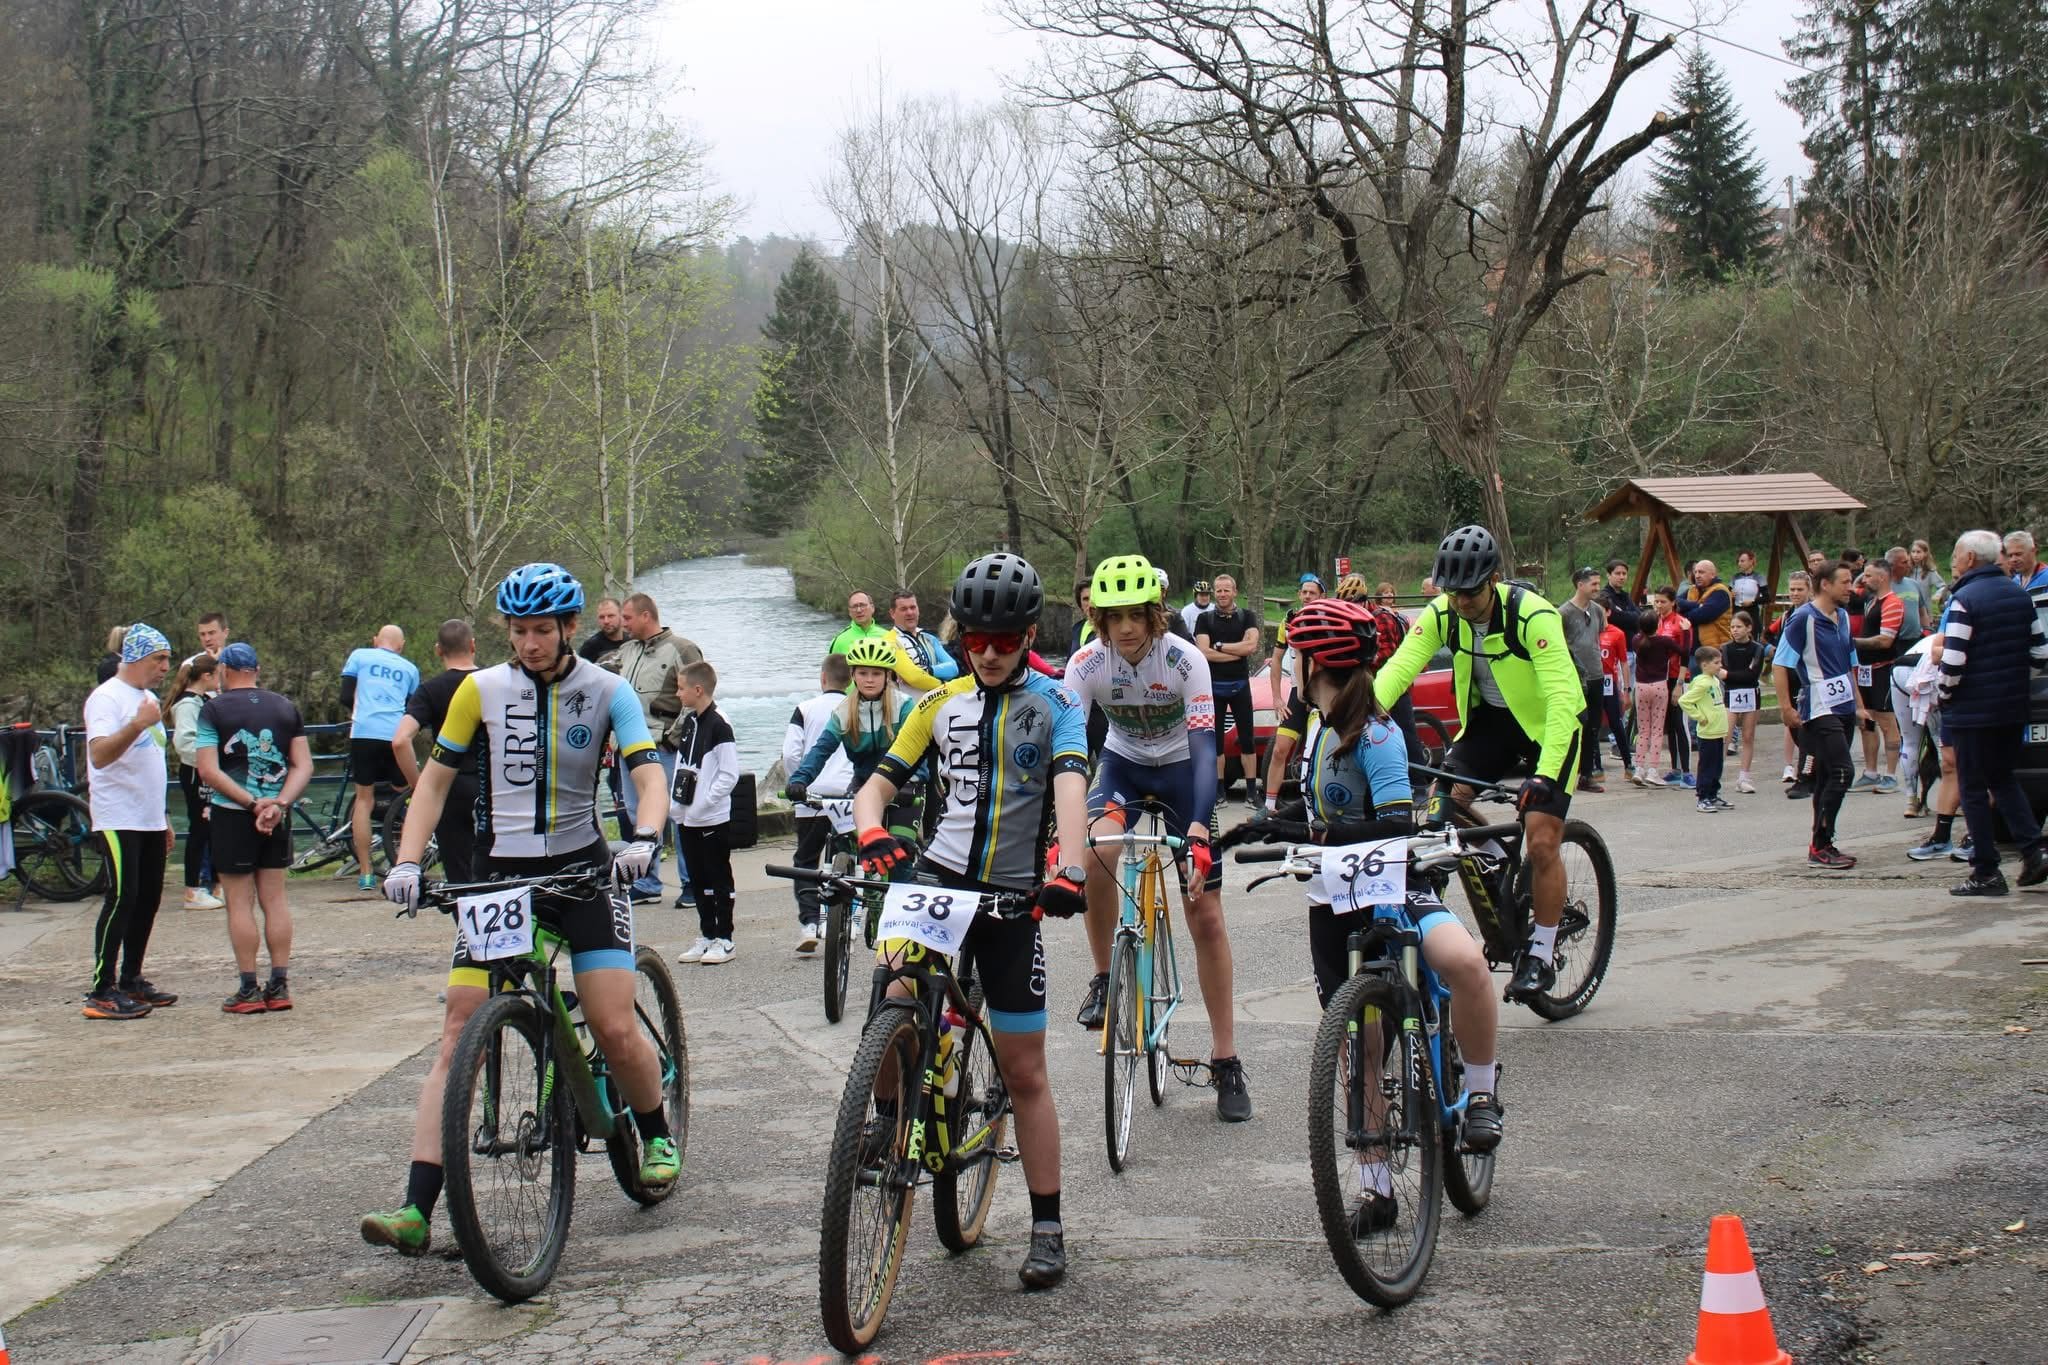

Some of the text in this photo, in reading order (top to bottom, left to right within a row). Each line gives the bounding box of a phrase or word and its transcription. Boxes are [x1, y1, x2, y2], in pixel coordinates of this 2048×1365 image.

[369, 664, 404, 683] CRO
[1826, 680, 1846, 696] 33
[1735, 693, 1749, 704] 41
[504, 704, 539, 786] GRT
[948, 714, 980, 806] GRT
[1340, 850, 1386, 882] 36
[467, 899, 524, 935] 128
[609, 893, 632, 944] GRT
[902, 893, 954, 921] 38
